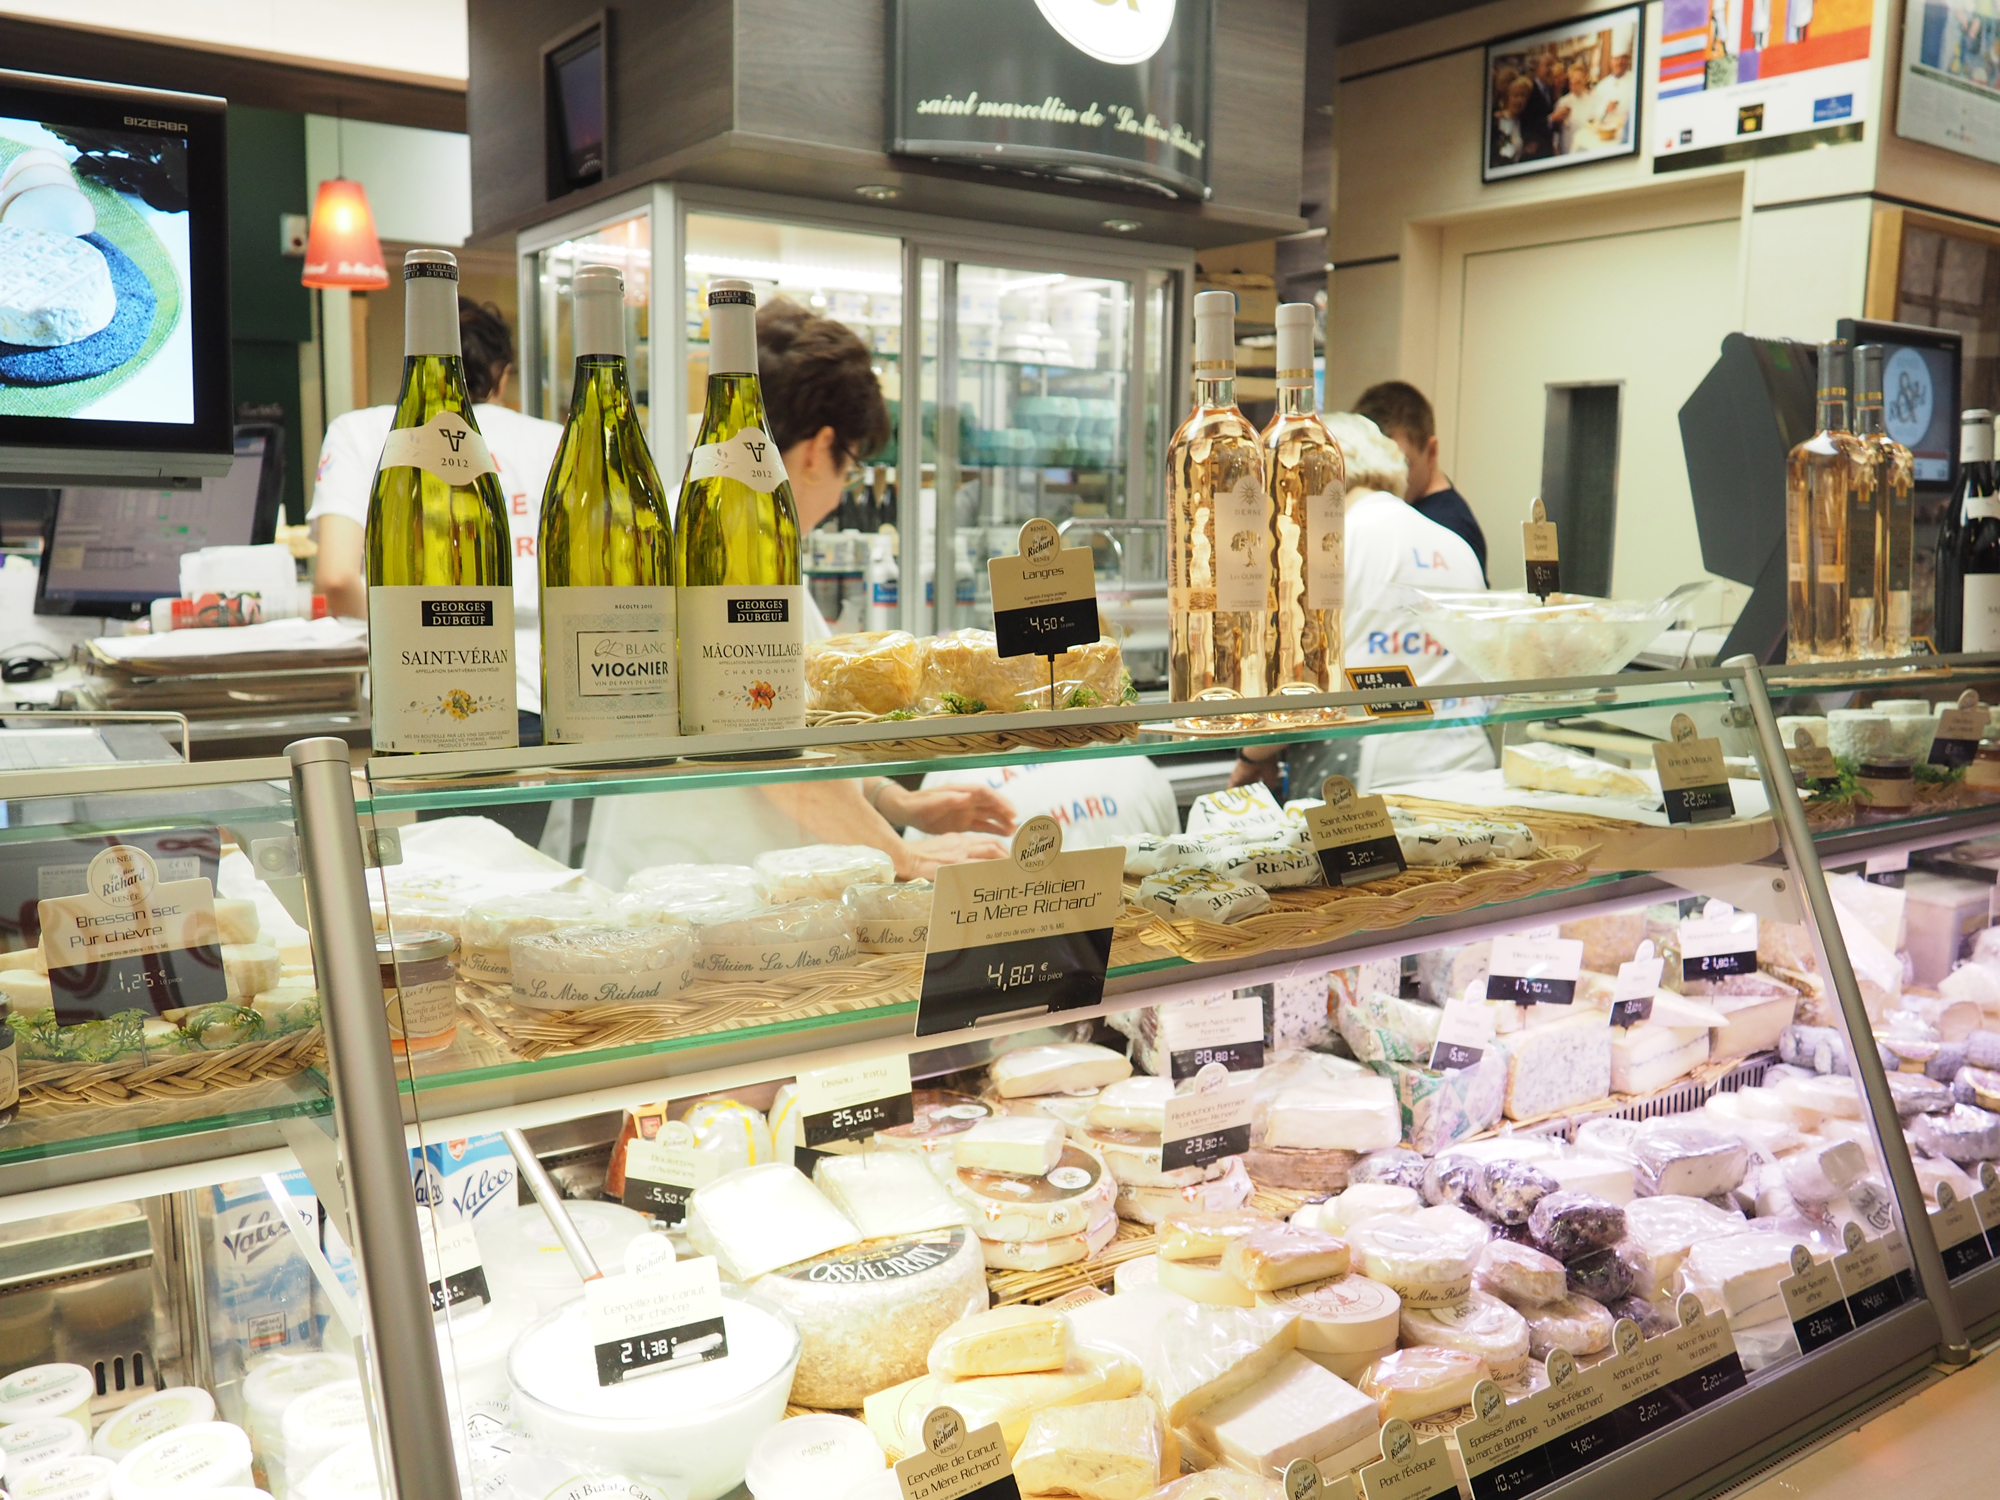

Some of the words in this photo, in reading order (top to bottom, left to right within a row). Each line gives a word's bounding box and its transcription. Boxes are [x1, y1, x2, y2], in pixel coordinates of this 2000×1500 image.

[917, 91, 977, 115] saint
[977, 96, 1080, 123] marcellin
[1080, 102, 1106, 127] de
[123, 116, 188, 132] BIZERBA
[441, 458, 469, 468] 2012
[751, 470, 773, 479] 2012
[1027, 536, 1054, 557] Richard
[1413, 548, 1449, 571] LA
[1022, 567, 1064, 580] Langres
[431, 602, 486, 612] GEORGES
[736, 600, 783, 610] GEORGES
[432, 616, 486, 626] DUBŒUF
[737, 613, 783, 622] DUBŒUF
[1030, 617, 1058, 633] 4,50
[401, 647, 508, 665] SAINT-VÉRAN
[626, 641, 666, 655] BLANC
[591, 661, 669, 677] VIOGNIER
[1029, 824, 1050, 832] RENÉE
[1320, 810, 1378, 827] Saint-Marcellin
[1332, 826, 1353, 836] Mère
[106, 854, 134, 864] RENÉE
[1019, 837, 1055, 861] Richard
[1347, 851, 1371, 866] 3,20
[1025, 860, 1045, 868] RENÉE
[102, 868, 146, 897] Richard
[973, 879, 1086, 904] Saint-Félicien
[112, 892, 141, 904] RENÉE
[76, 908, 146, 929] Bressan
[152, 904, 182, 918] sec
[950, 907, 977, 925] "La
[983, 903, 1028, 921] Mère
[1033, 892, 1102, 914] Richard"
[70, 934, 99, 949] Pur
[105, 925, 163, 945] chèvre
[872, 926, 904, 945] Mère
[1020, 926, 1036, 935] vache
[468, 953, 509, 975] Félicien
[707, 953, 753, 972] Félicien
[759, 952, 782, 971] La
[786, 951, 822, 969] Mère
[118, 971, 154, 993] 1,25
[987, 962, 1035, 992] 4,80
[1040, 962, 1049, 971] €
[1038, 974, 1047, 982] La
[1047, 971, 1063, 982] pièce
[530, 978, 548, 1000] La
[551, 983, 589, 1001] Mère
[594, 980, 661, 1001] Richard
[832, 1108, 872, 1128] 25,50
[1172, 1102, 1215, 1121] Reblochon
[1185, 1138, 1218, 1154] 23,90
[452, 1169, 513, 1220] Valco
[636, 1250, 666, 1275] Richard
[809, 1243, 947, 1283] OSSAU-IRATY
[604, 1298, 650, 1316] Cervelle
[654, 1293, 668, 1305] de
[672, 1286, 707, 1300] canut
[1411, 1287, 1438, 1302] Mère
[624, 1312, 645, 1324] Pur
[649, 1303, 690, 1319] chèvre
[1676, 1337, 1697, 1352] Arôme
[1698, 1332, 1707, 1342] de
[1707, 1325, 1723, 1340] Lyon
[620, 1339, 668, 1364] 21,38
[1689, 1350, 1698, 1360] au
[1699, 1341, 1718, 1357] poivre
[1612, 1365, 1635, 1381] Arôme
[1636, 1360, 1645, 1372] de
[1645, 1352, 1663, 1367] Lyon
[1621, 1382, 1631, 1392] au
[1632, 1376, 1642, 1387] vin
[1643, 1366, 1661, 1381] blanc
[1701, 1374, 1720, 1392] 2,20
[1482, 1394, 1501, 1419] Richard
[1547, 1385, 1594, 1412] Saint-Félicien
[1556, 1407, 1575, 1422] Mère
[1638, 1404, 1658, 1422] 2,20
[932, 1421, 959, 1450] Richard
[1469, 1427, 1504, 1449] Epoisses
[1505, 1415, 1527, 1433] affiné
[1390, 1433, 1411, 1459] Richard
[1466, 1456, 1476, 1466] au
[1476, 1447, 1493, 1460] marc
[1494, 1442, 1503, 1453] de
[1503, 1426, 1539, 1447] Bourgogne
[907, 1462, 949, 1486] Cervelle
[950, 1455, 965, 1468] de
[966, 1441, 998, 1461] Canut
[1379, 1473, 1401, 1488] Pont
[1402, 1457, 1436, 1479] l'Évêque
[930, 1475, 959, 1491] Mère
